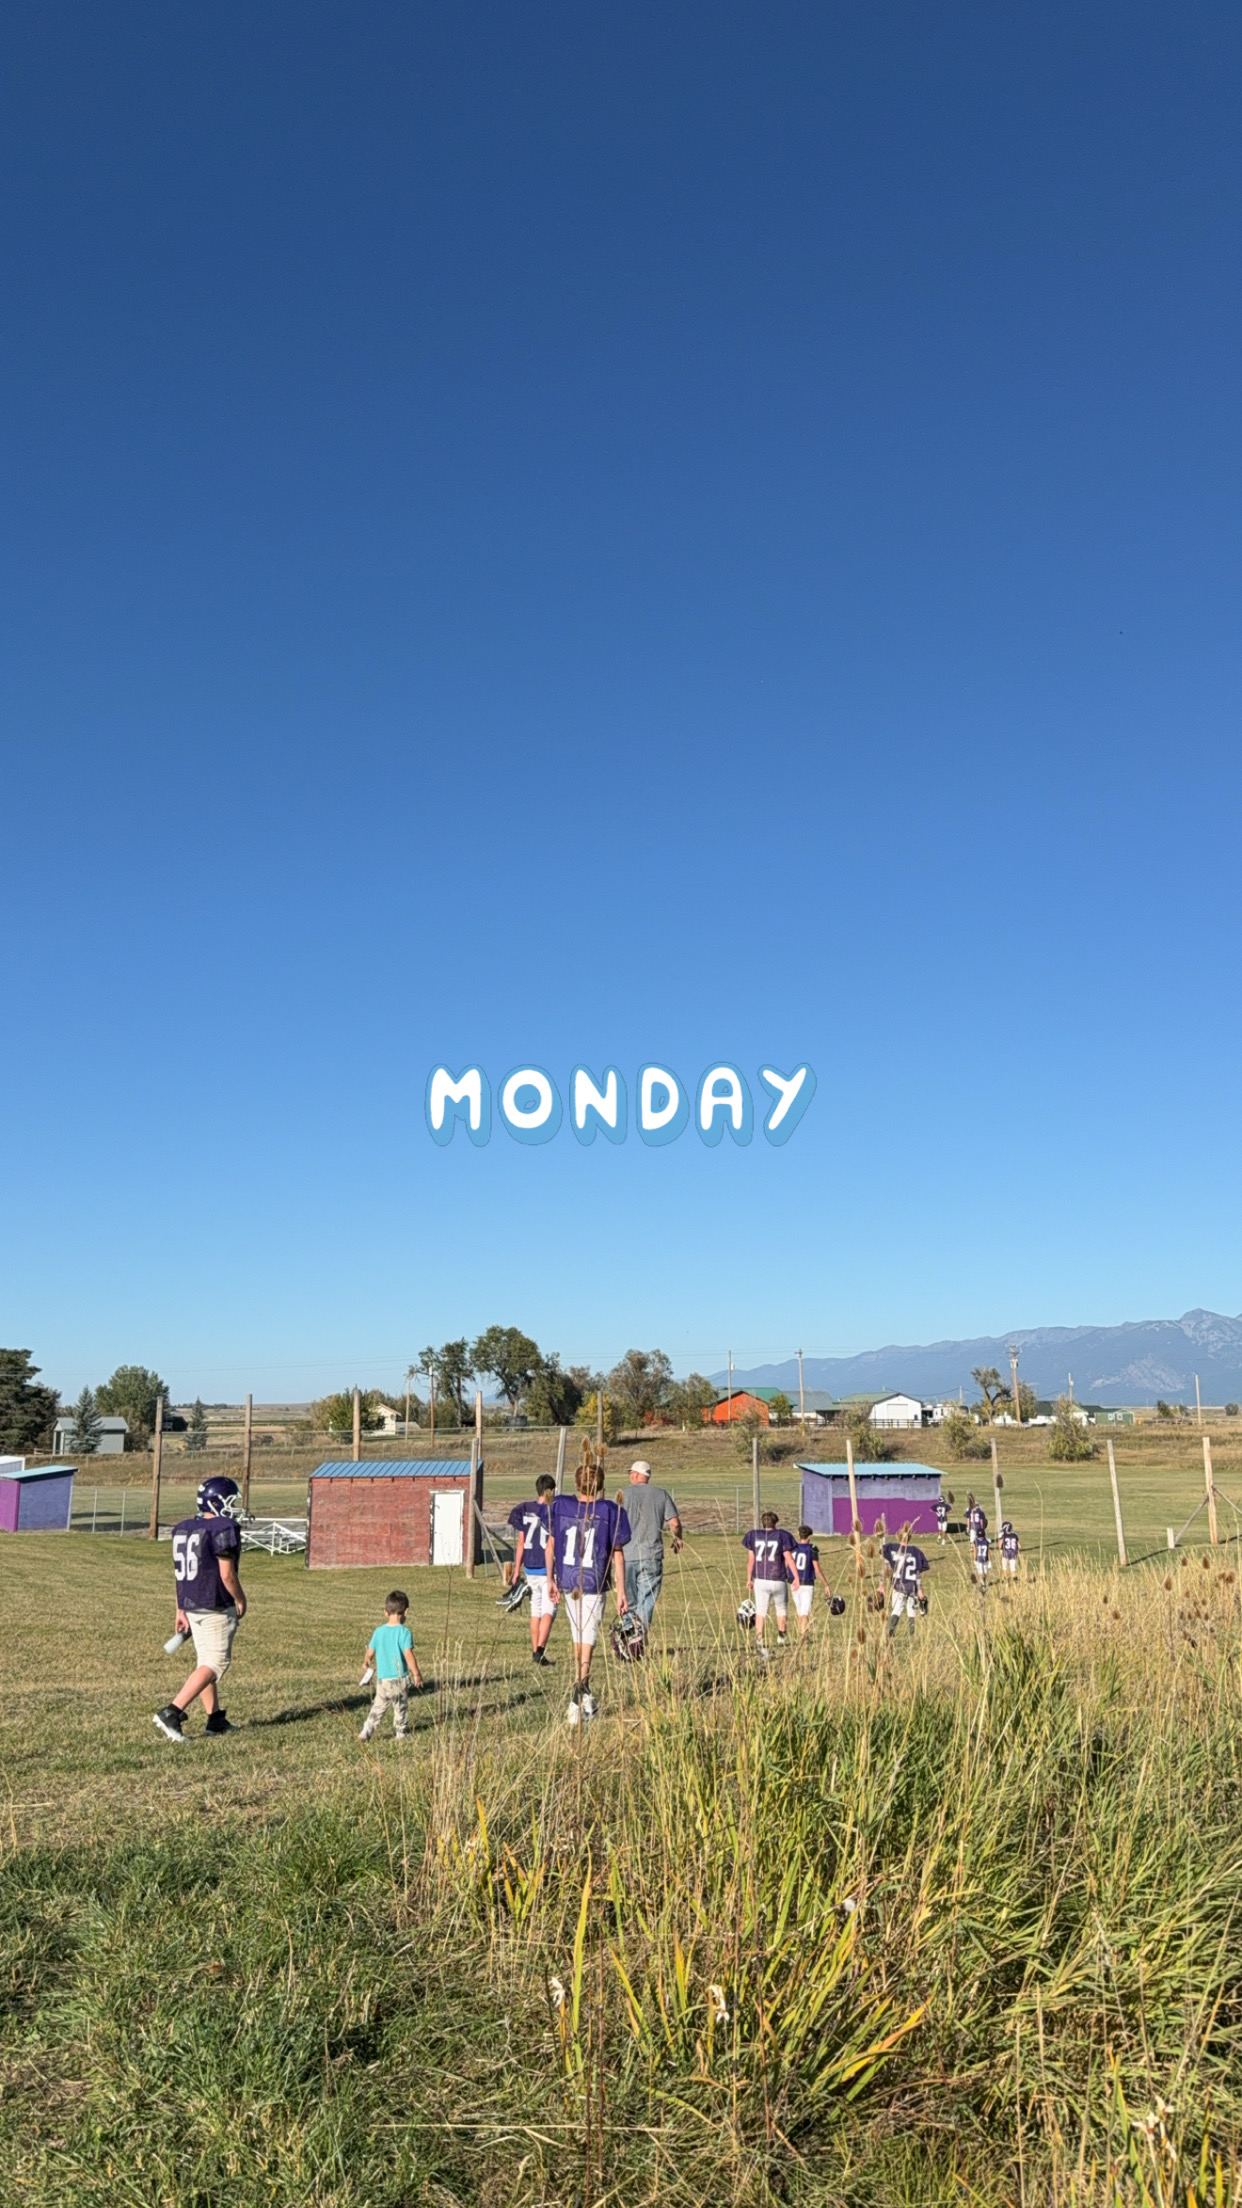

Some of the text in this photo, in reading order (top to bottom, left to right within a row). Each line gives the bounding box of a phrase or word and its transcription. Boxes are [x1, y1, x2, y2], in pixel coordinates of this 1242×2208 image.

[173, 1534, 199, 1581] 56
[563, 1526, 595, 1568] 11
[755, 1541, 778, 1562] 77
[977, 1545, 988, 1557] 17
[890, 1551, 917, 1580] 72
